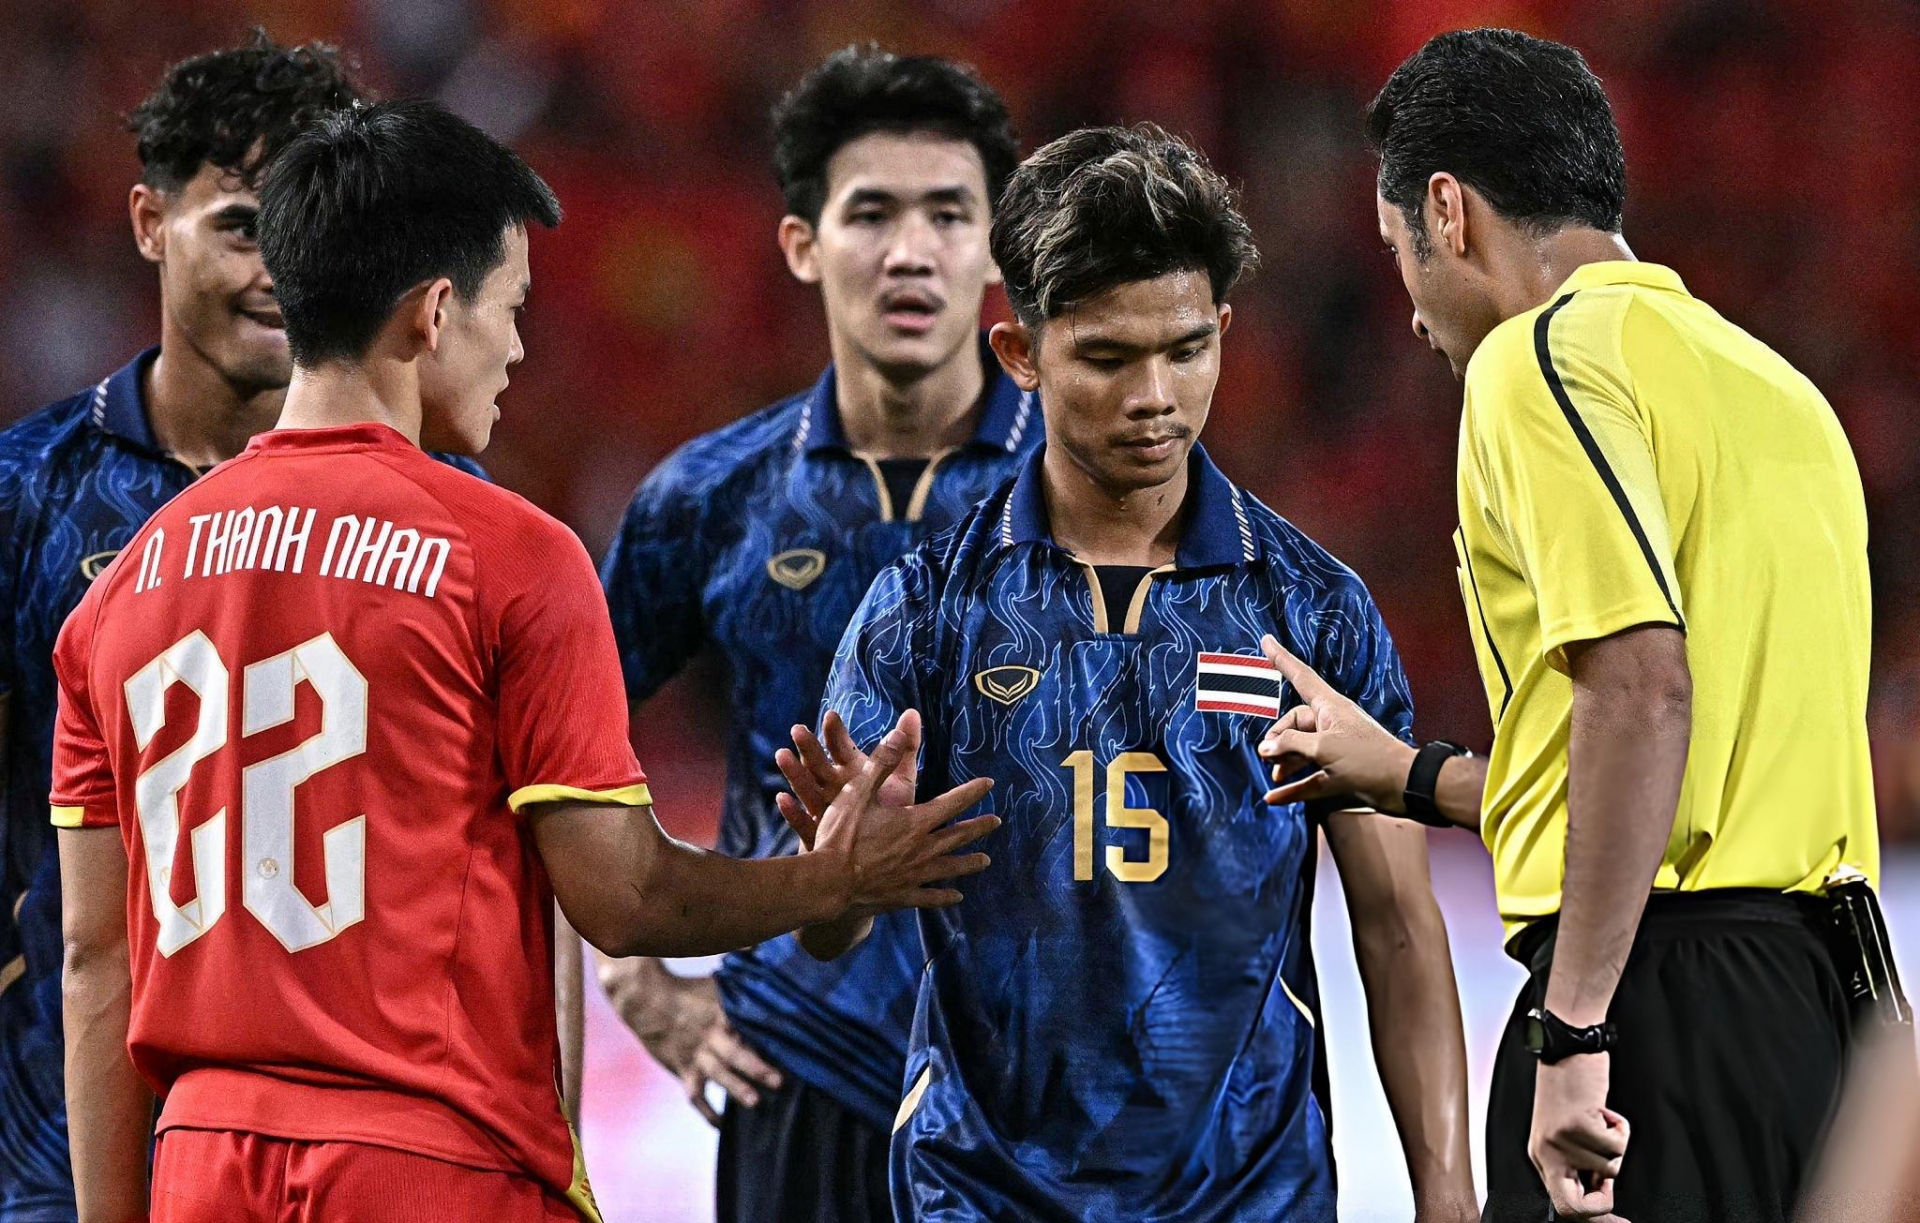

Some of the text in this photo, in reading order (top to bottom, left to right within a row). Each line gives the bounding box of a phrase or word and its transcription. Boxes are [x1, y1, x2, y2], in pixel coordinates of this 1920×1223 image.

[183, 505, 317, 580] THANH
[319, 514, 451, 598] NHAN
[124, 629, 368, 958] 22
[1060, 749, 1168, 882] 15
